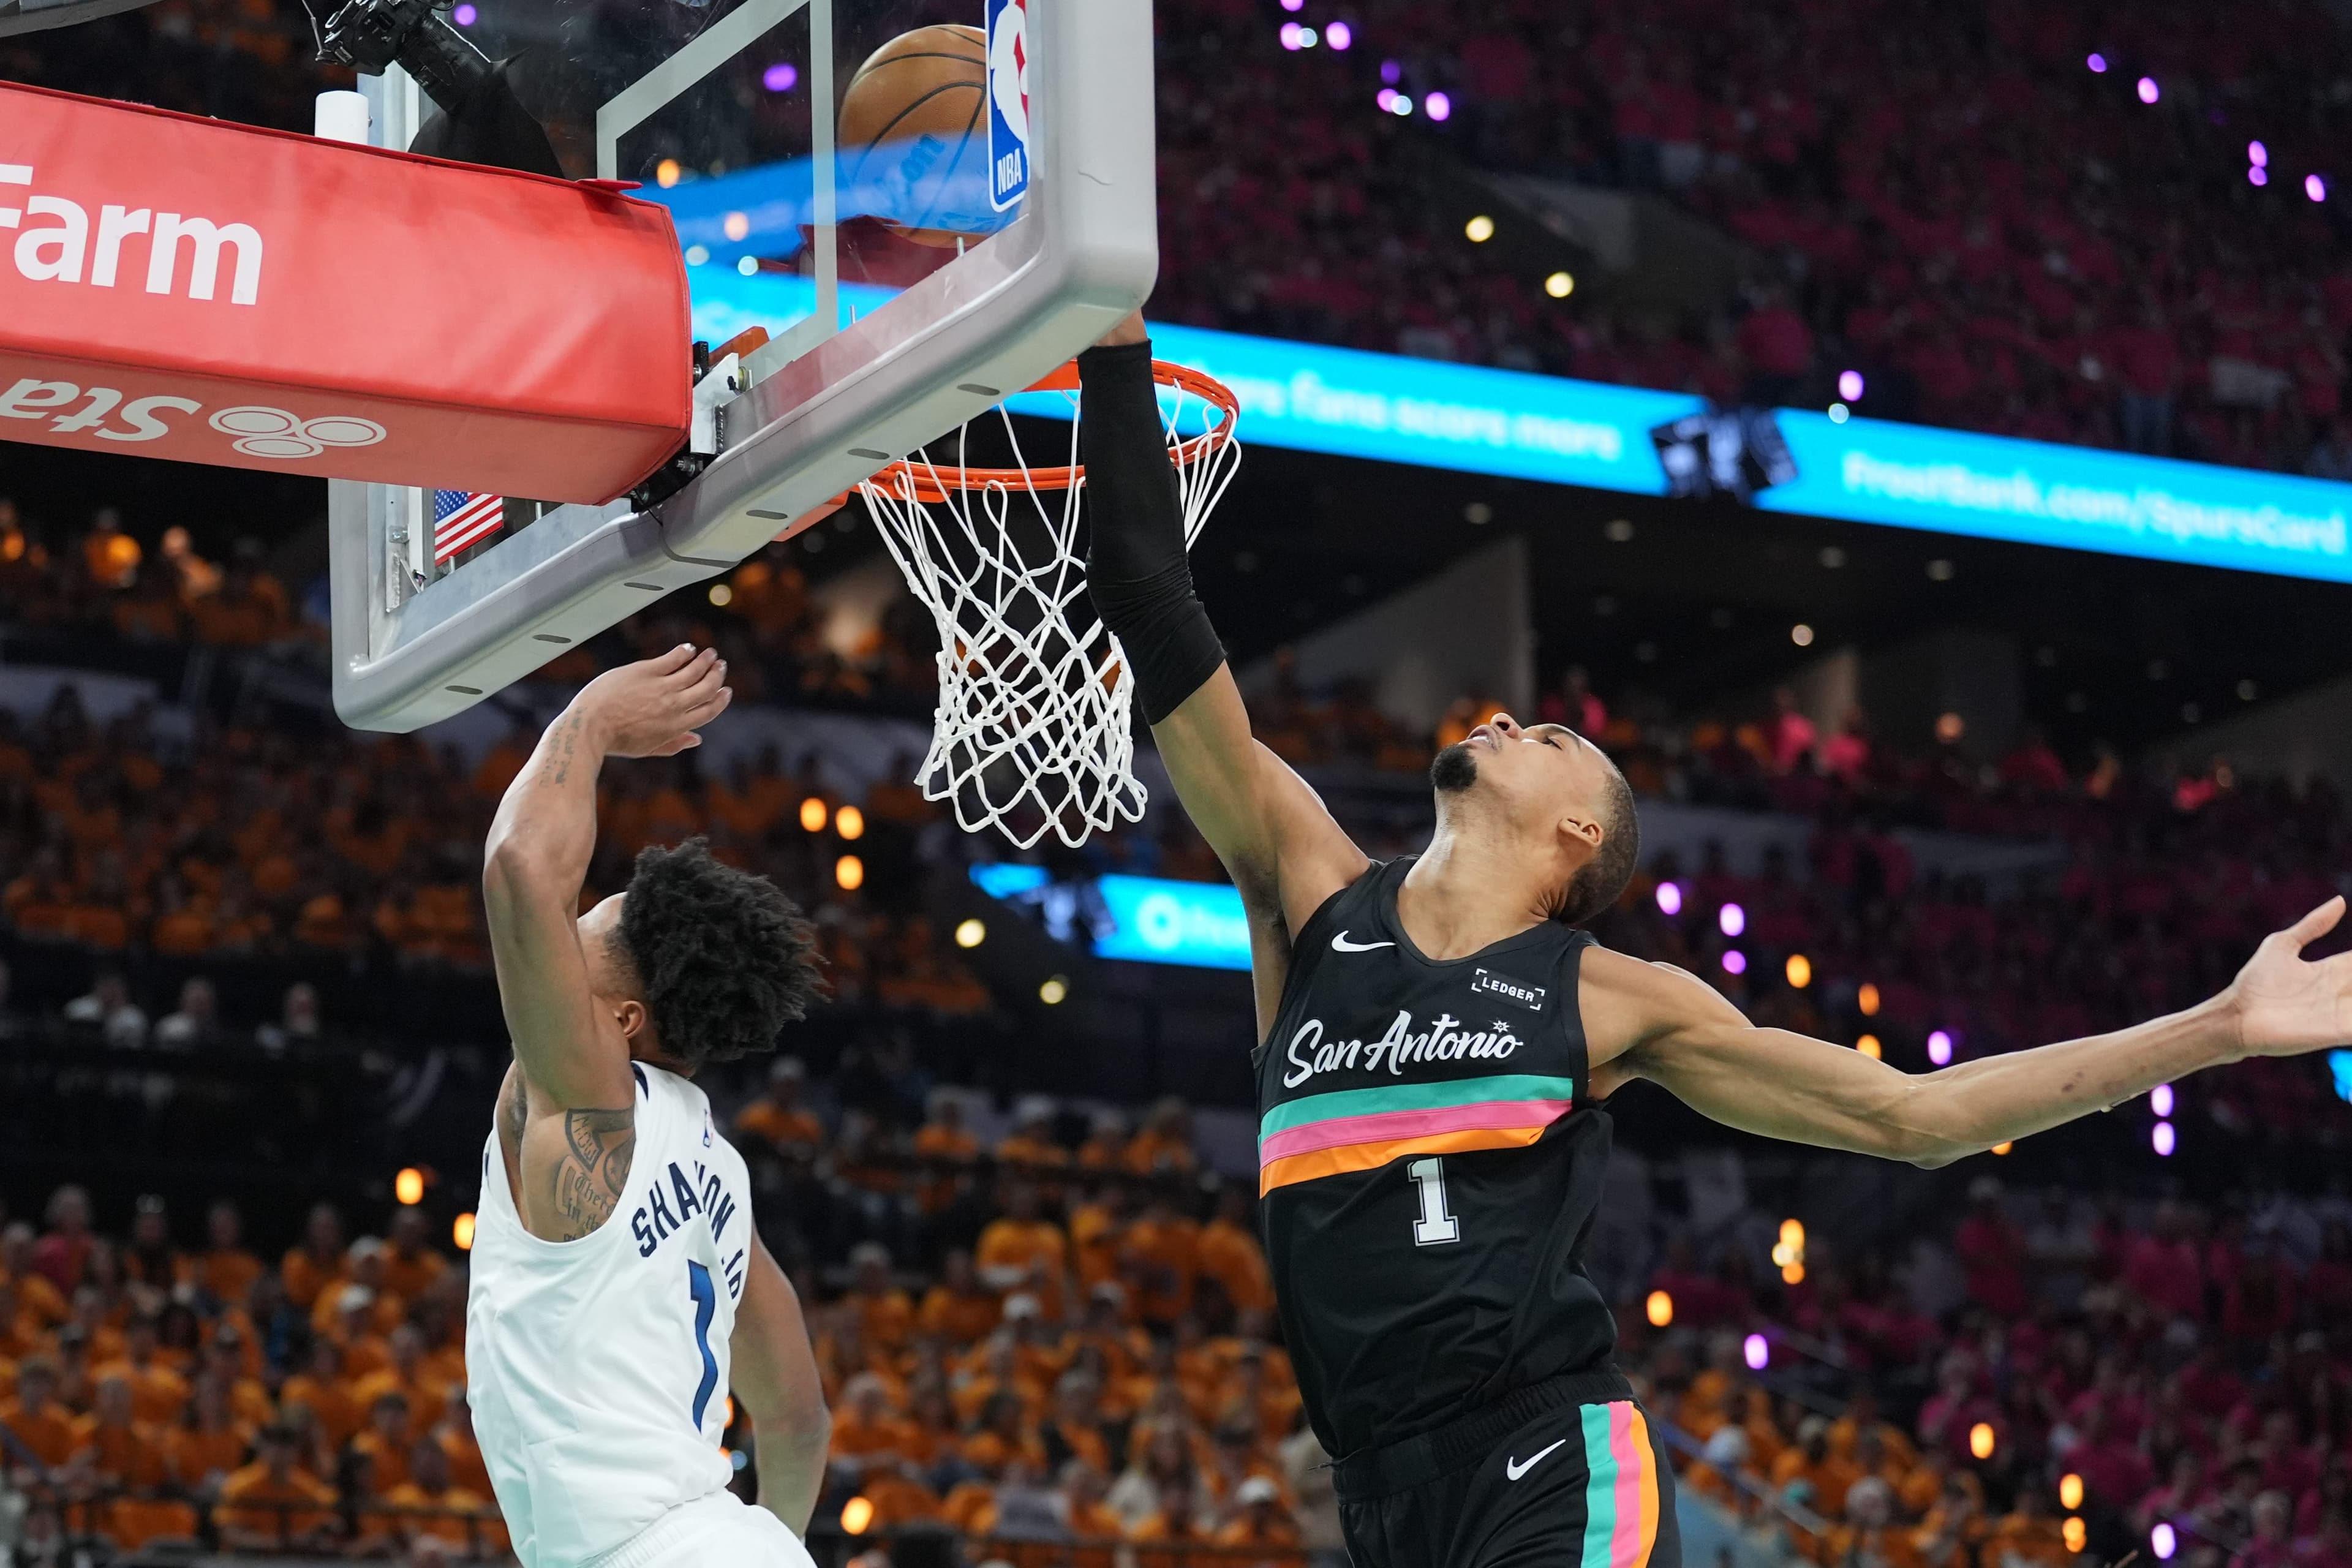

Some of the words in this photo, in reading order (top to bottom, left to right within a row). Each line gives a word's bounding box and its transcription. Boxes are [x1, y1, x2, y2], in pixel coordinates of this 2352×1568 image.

[997, 148, 1022, 195] NBA
[1482, 976, 1535, 1003] LEDGER
[1283, 1019, 1362, 1088] San
[1363, 1010, 1524, 1076] Antonio
[1406, 1156, 1460, 1247] 1
